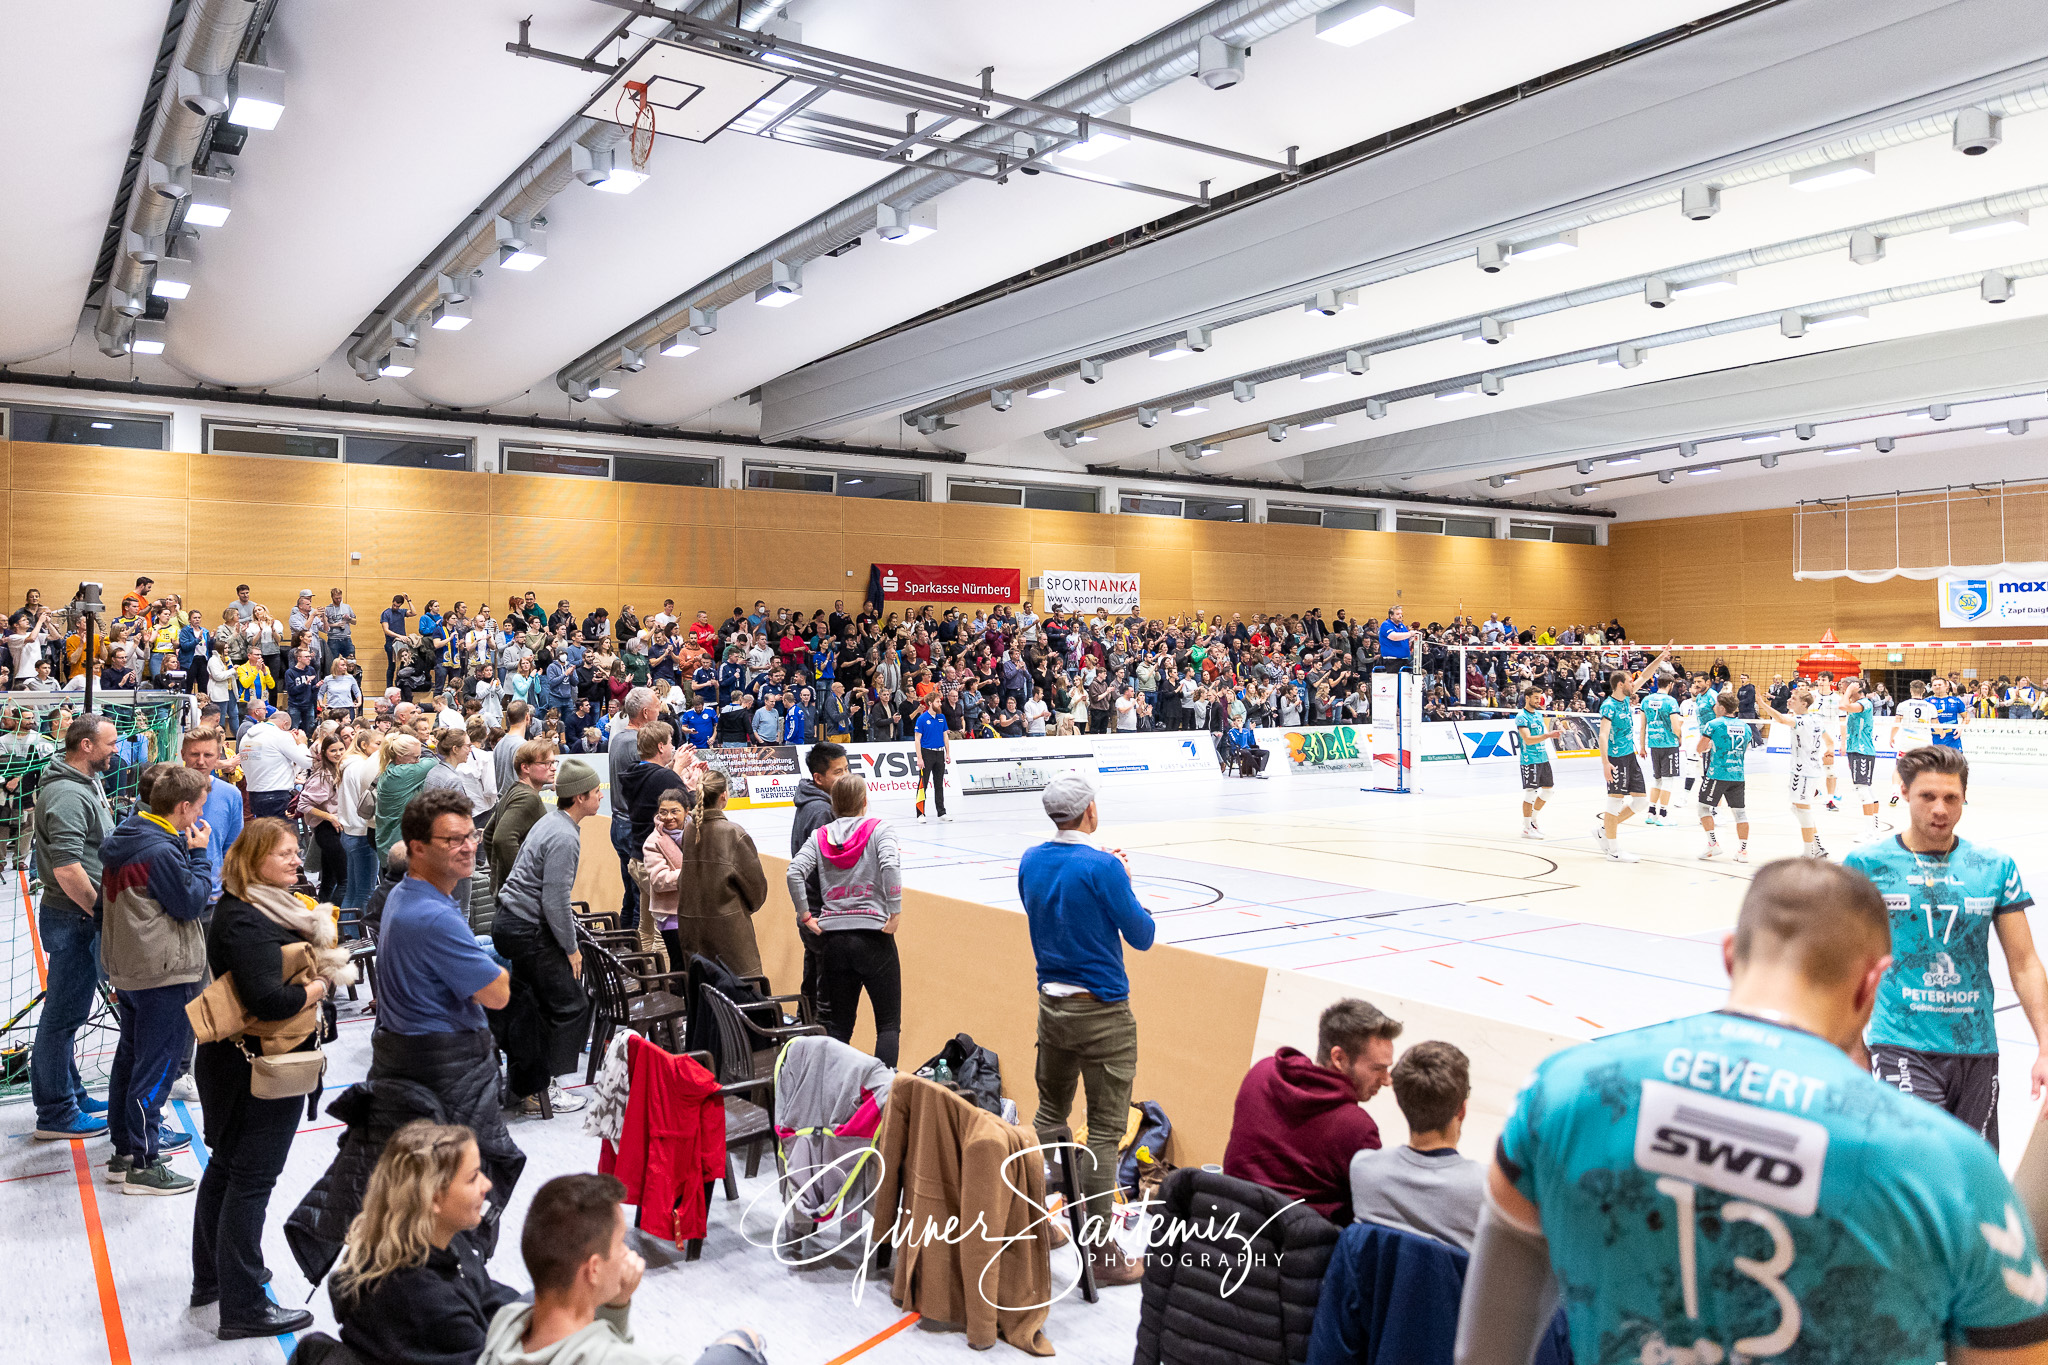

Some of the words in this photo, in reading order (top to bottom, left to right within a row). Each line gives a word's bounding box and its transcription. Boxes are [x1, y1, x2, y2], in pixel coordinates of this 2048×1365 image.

[904, 581, 960, 595] Sparkasse
[962, 582, 1011, 598] Nürnberg
[1047, 578, 1137, 592] SPORTNANKA
[1999, 581, 2048, 593] max
[1047, 594, 1138, 606] www.sportnanka.de
[1653, 708, 1659, 720] 7
[1914, 707, 1922, 718] 9
[1730, 734, 1745, 750] 12
[716, 752, 740, 760] Partner
[867, 777, 951, 792] Werbetek
[760, 791, 795, 799] SERVICES
[1919, 903, 1959, 945] 17
[1923, 972, 1961, 987] gepe
[1902, 986, 1980, 1004] PETERHOFF
[1662, 1048, 1827, 1113] GEVERT
[1651, 1126, 1803, 1188] SWD
[1655, 1177, 1802, 1357] 13
